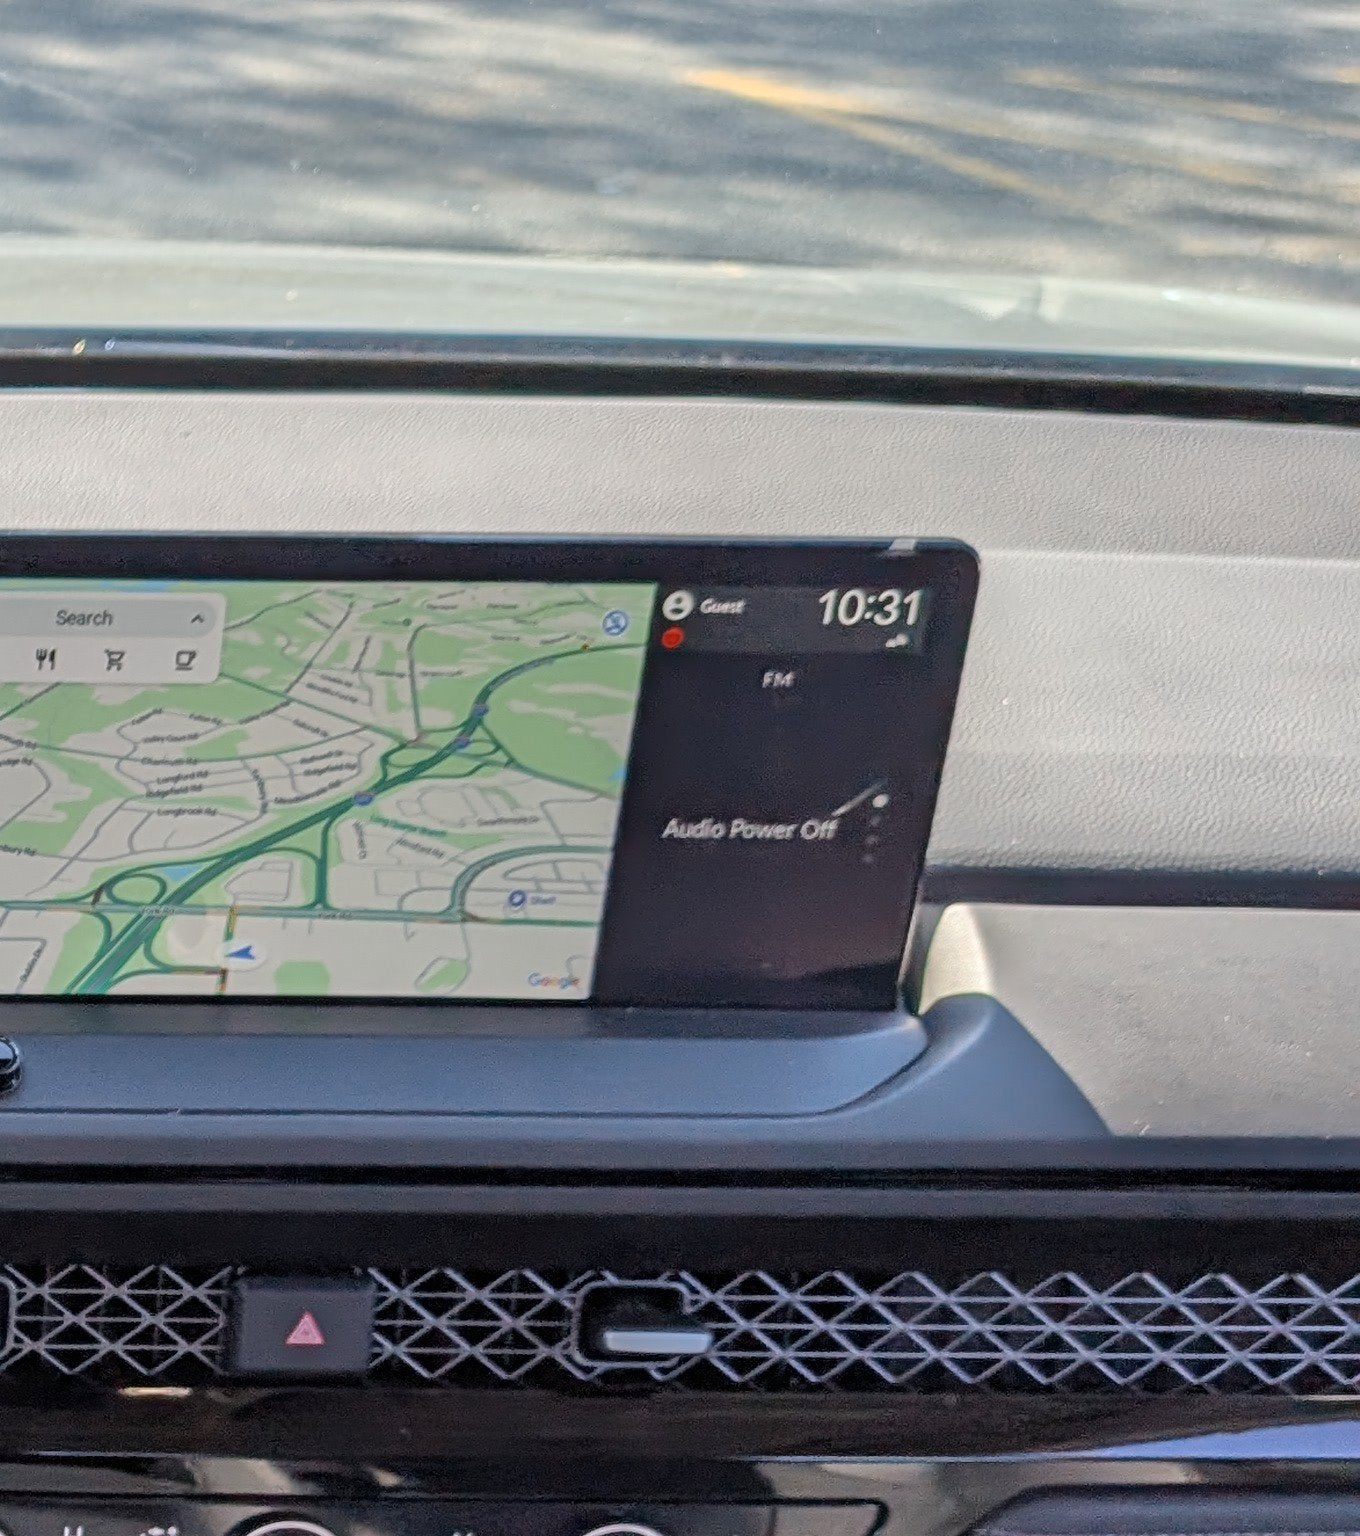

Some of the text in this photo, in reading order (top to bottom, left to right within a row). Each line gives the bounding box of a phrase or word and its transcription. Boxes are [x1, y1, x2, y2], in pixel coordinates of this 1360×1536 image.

[699, 598, 746, 614] Guest
[818, 588, 925, 626] 10:31
[55, 609, 113, 627] Search
[762, 671, 796, 688] FM
[662, 818, 839, 841] Audio Power Off
